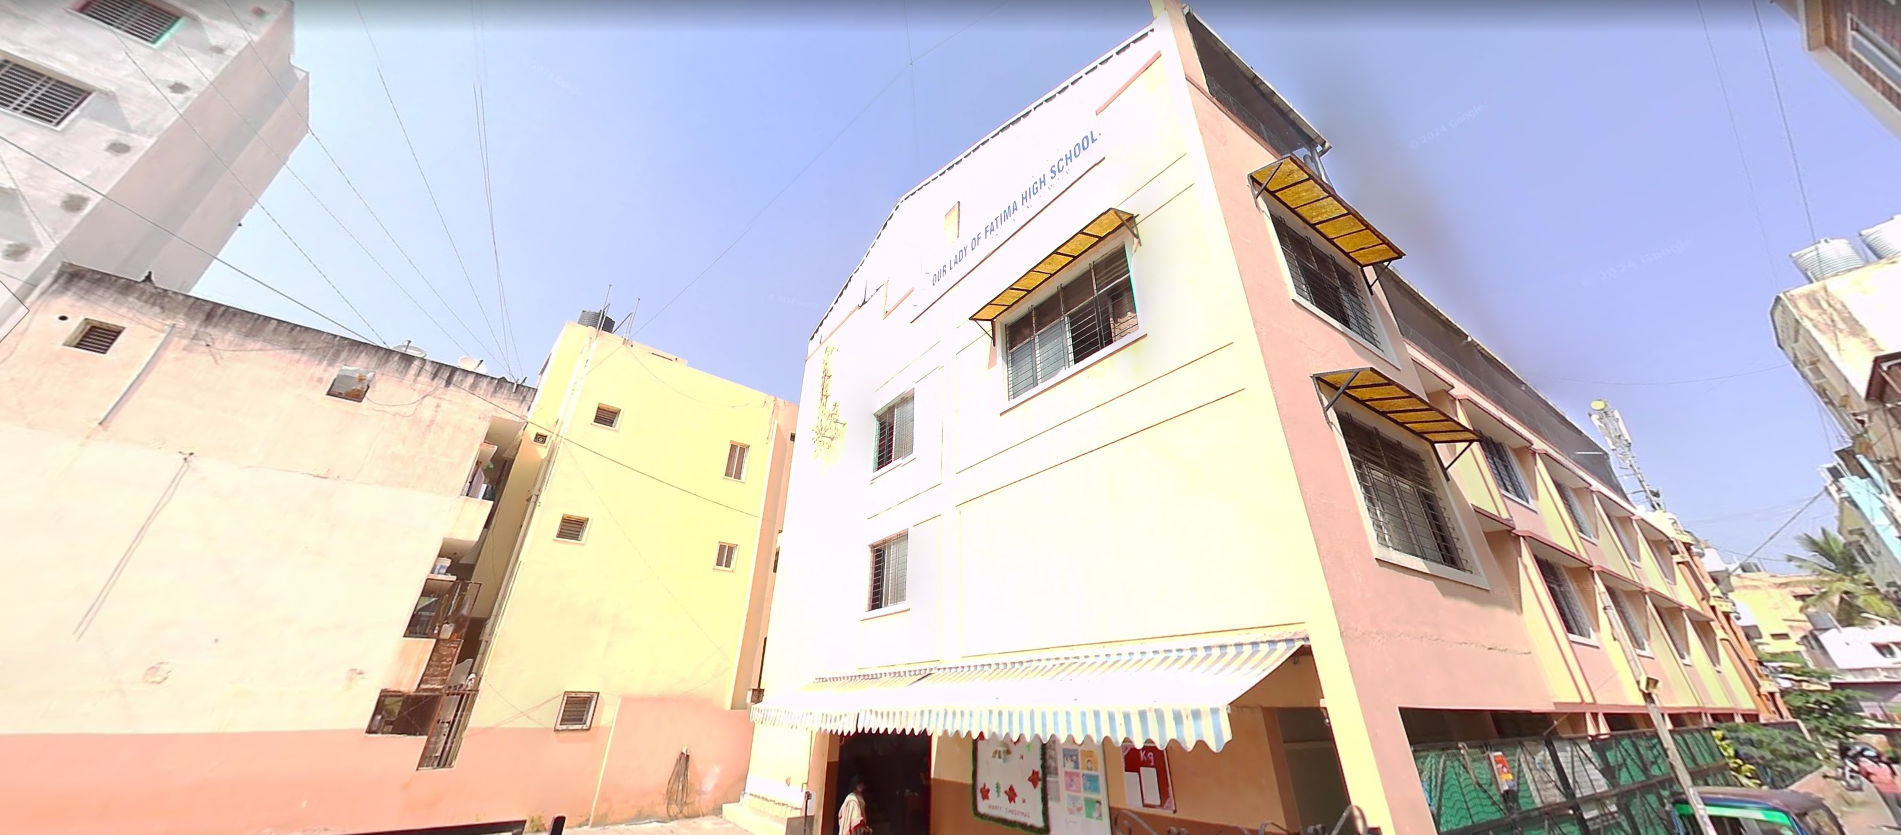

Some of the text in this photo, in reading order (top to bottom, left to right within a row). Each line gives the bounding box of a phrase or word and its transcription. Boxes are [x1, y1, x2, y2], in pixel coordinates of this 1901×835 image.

[932, 264, 947, 287] OUR
[949, 244, 969, 271] LADY
[971, 232, 982, 251] OF
[984, 200, 1019, 240] FATIMA
[1021, 173, 1047, 206] HIGH
